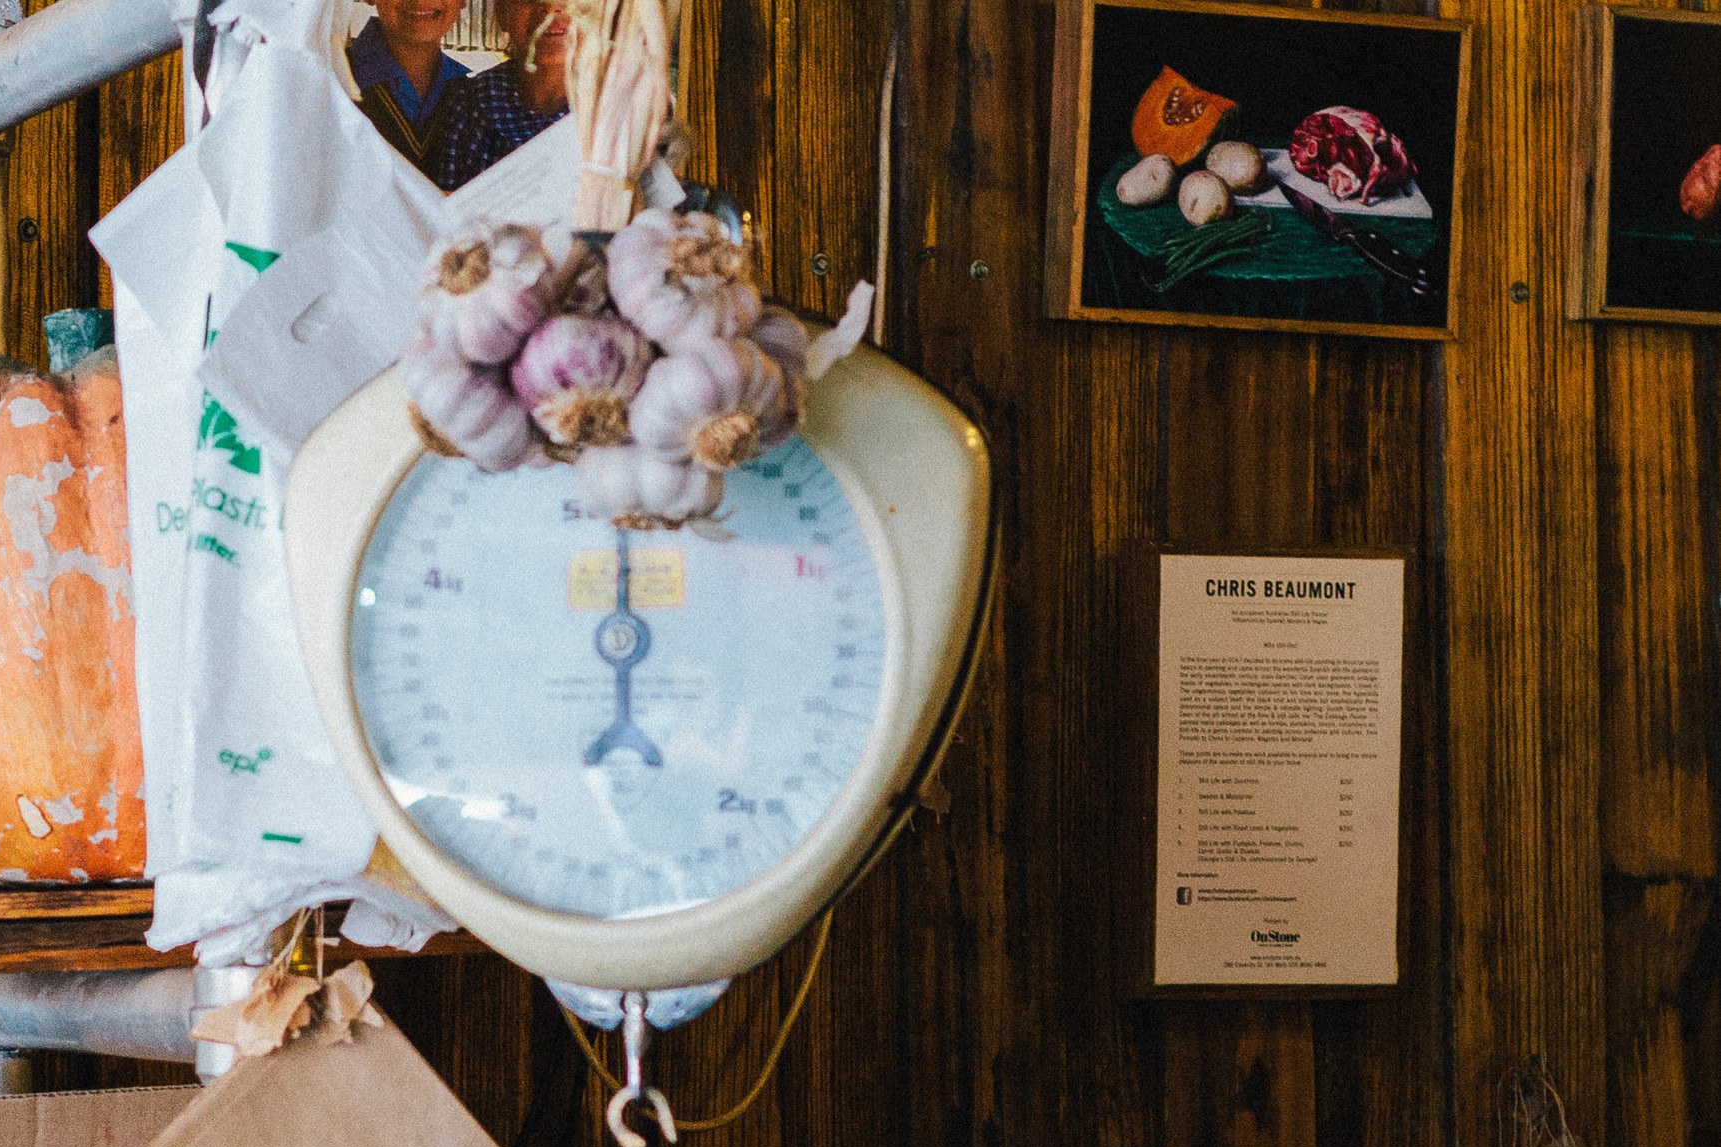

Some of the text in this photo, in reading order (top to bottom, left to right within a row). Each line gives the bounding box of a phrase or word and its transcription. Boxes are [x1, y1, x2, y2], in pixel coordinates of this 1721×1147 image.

[1206, 578, 1356, 600] CHRIS BEAUMONT
[1250, 929, 1301, 943] OnStone
